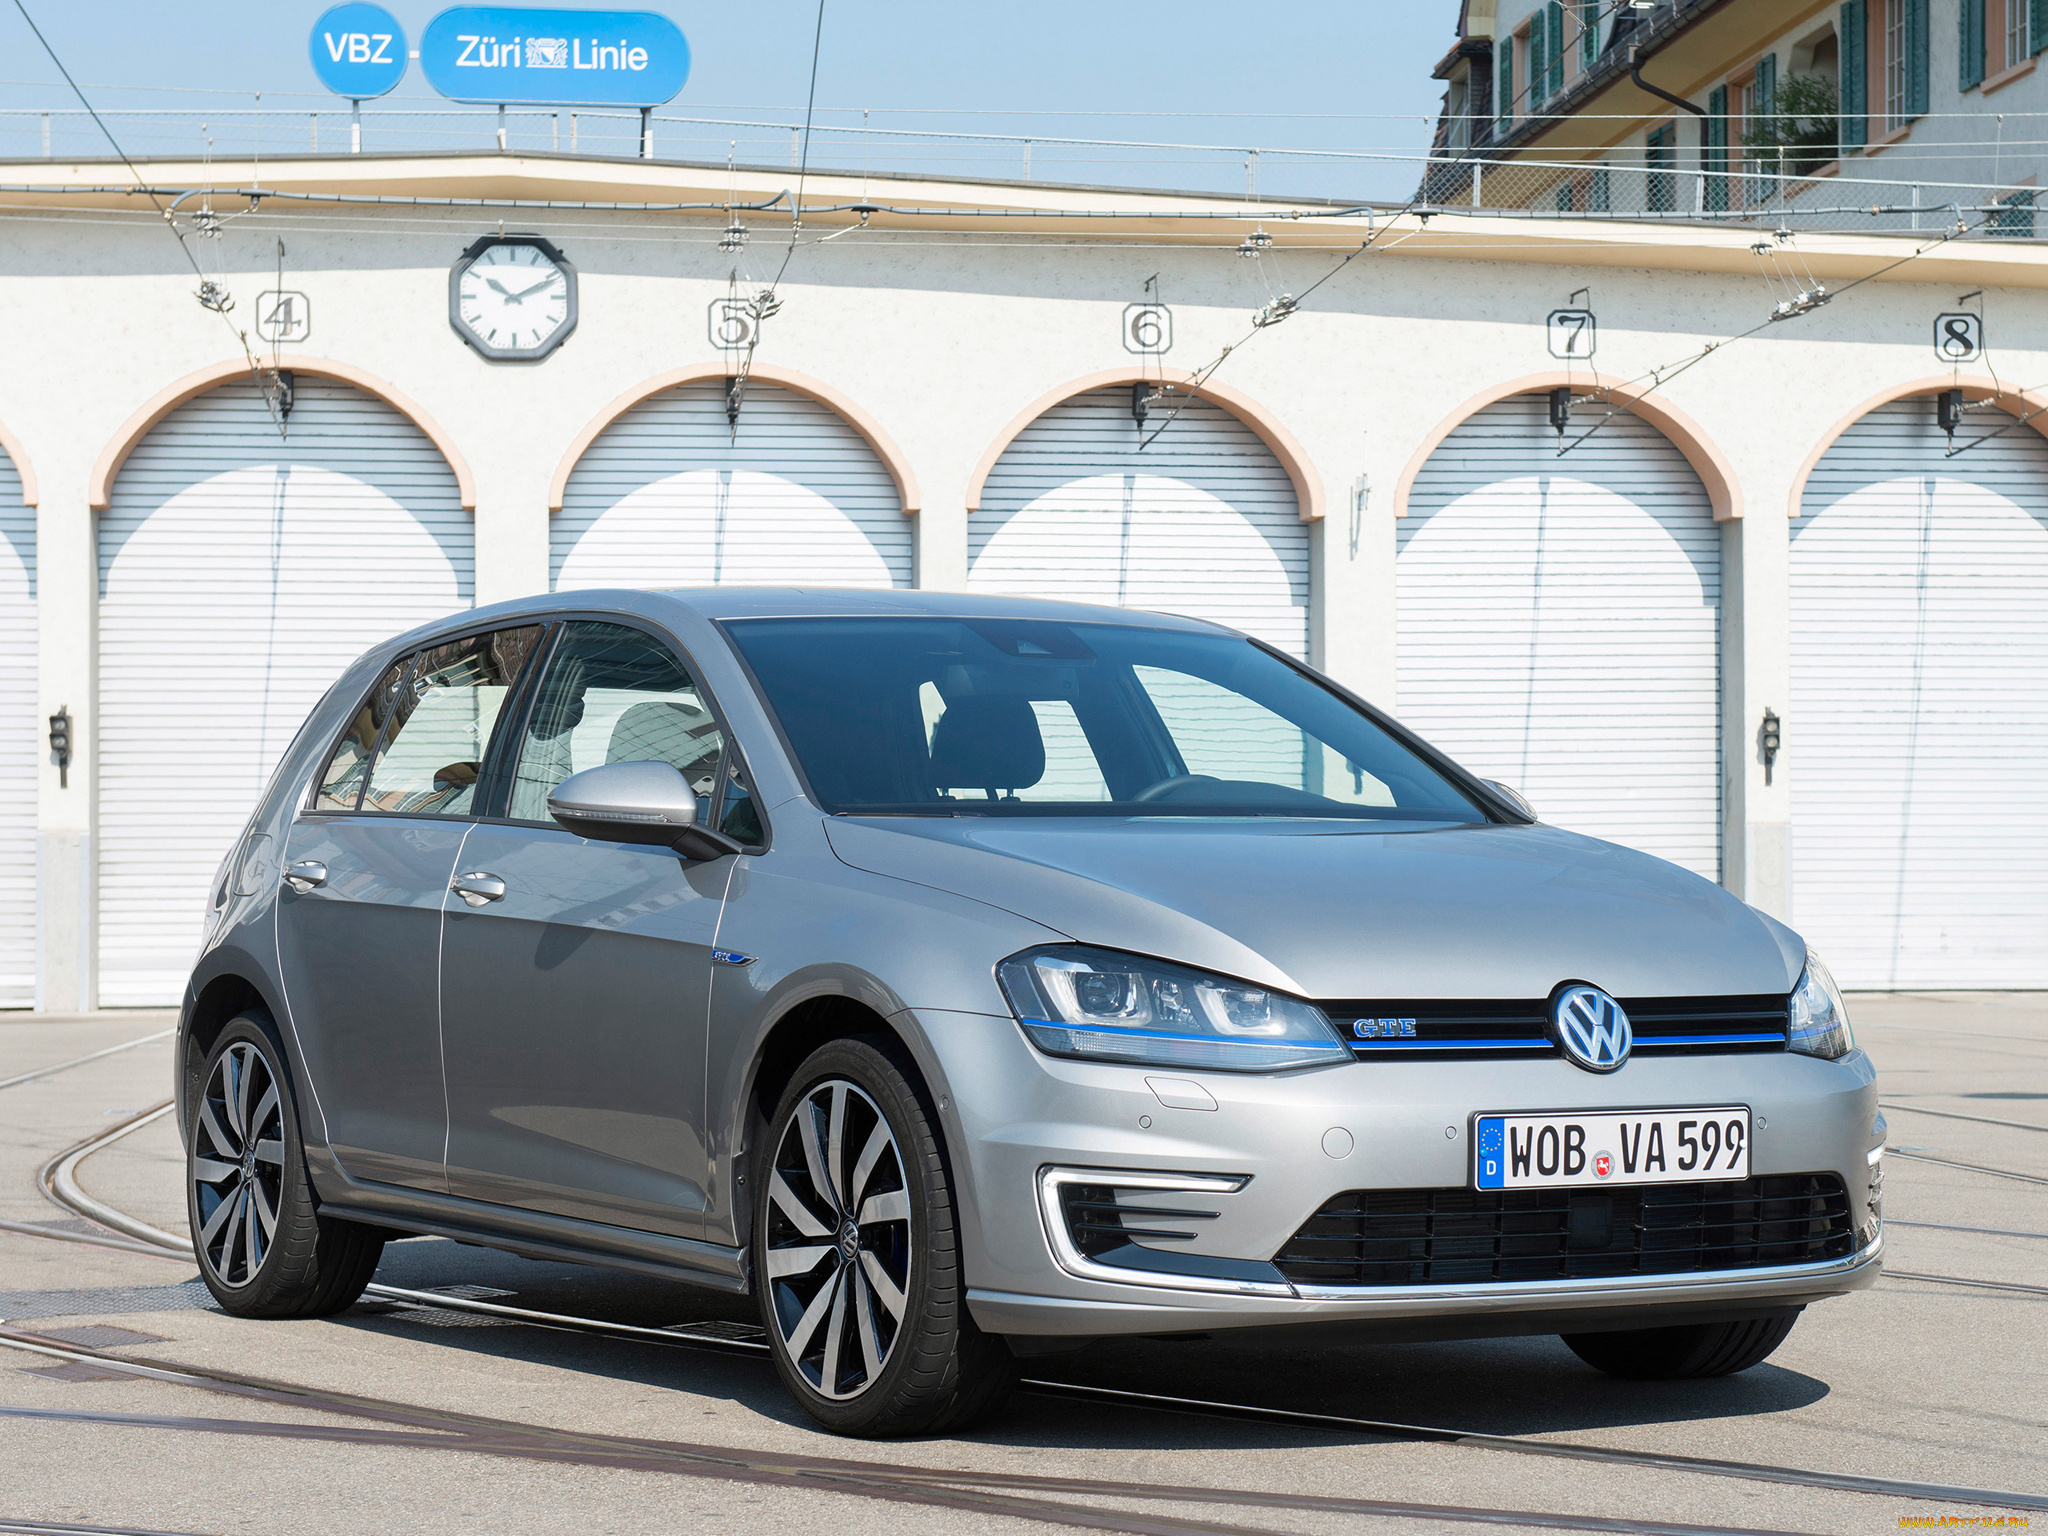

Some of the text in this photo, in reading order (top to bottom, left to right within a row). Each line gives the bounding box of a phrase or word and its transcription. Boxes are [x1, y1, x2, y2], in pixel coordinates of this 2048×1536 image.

[324, 32, 394, 64] VBZ
[456, 35, 649, 71] Züri Linie
[264, 297, 302, 336] 4
[718, 305, 750, 344] 5
[1131, 310, 1162, 347] 6
[1557, 315, 1587, 353] 7
[1943, 319, 1974, 357] 8
[1353, 1018, 1417, 1038] GTE
[1510, 1124, 1586, 1177] WOB
[1620, 1121, 1667, 1174] VA
[1677, 1119, 1745, 1171] 599
[1486, 1159, 1497, 1176] D
